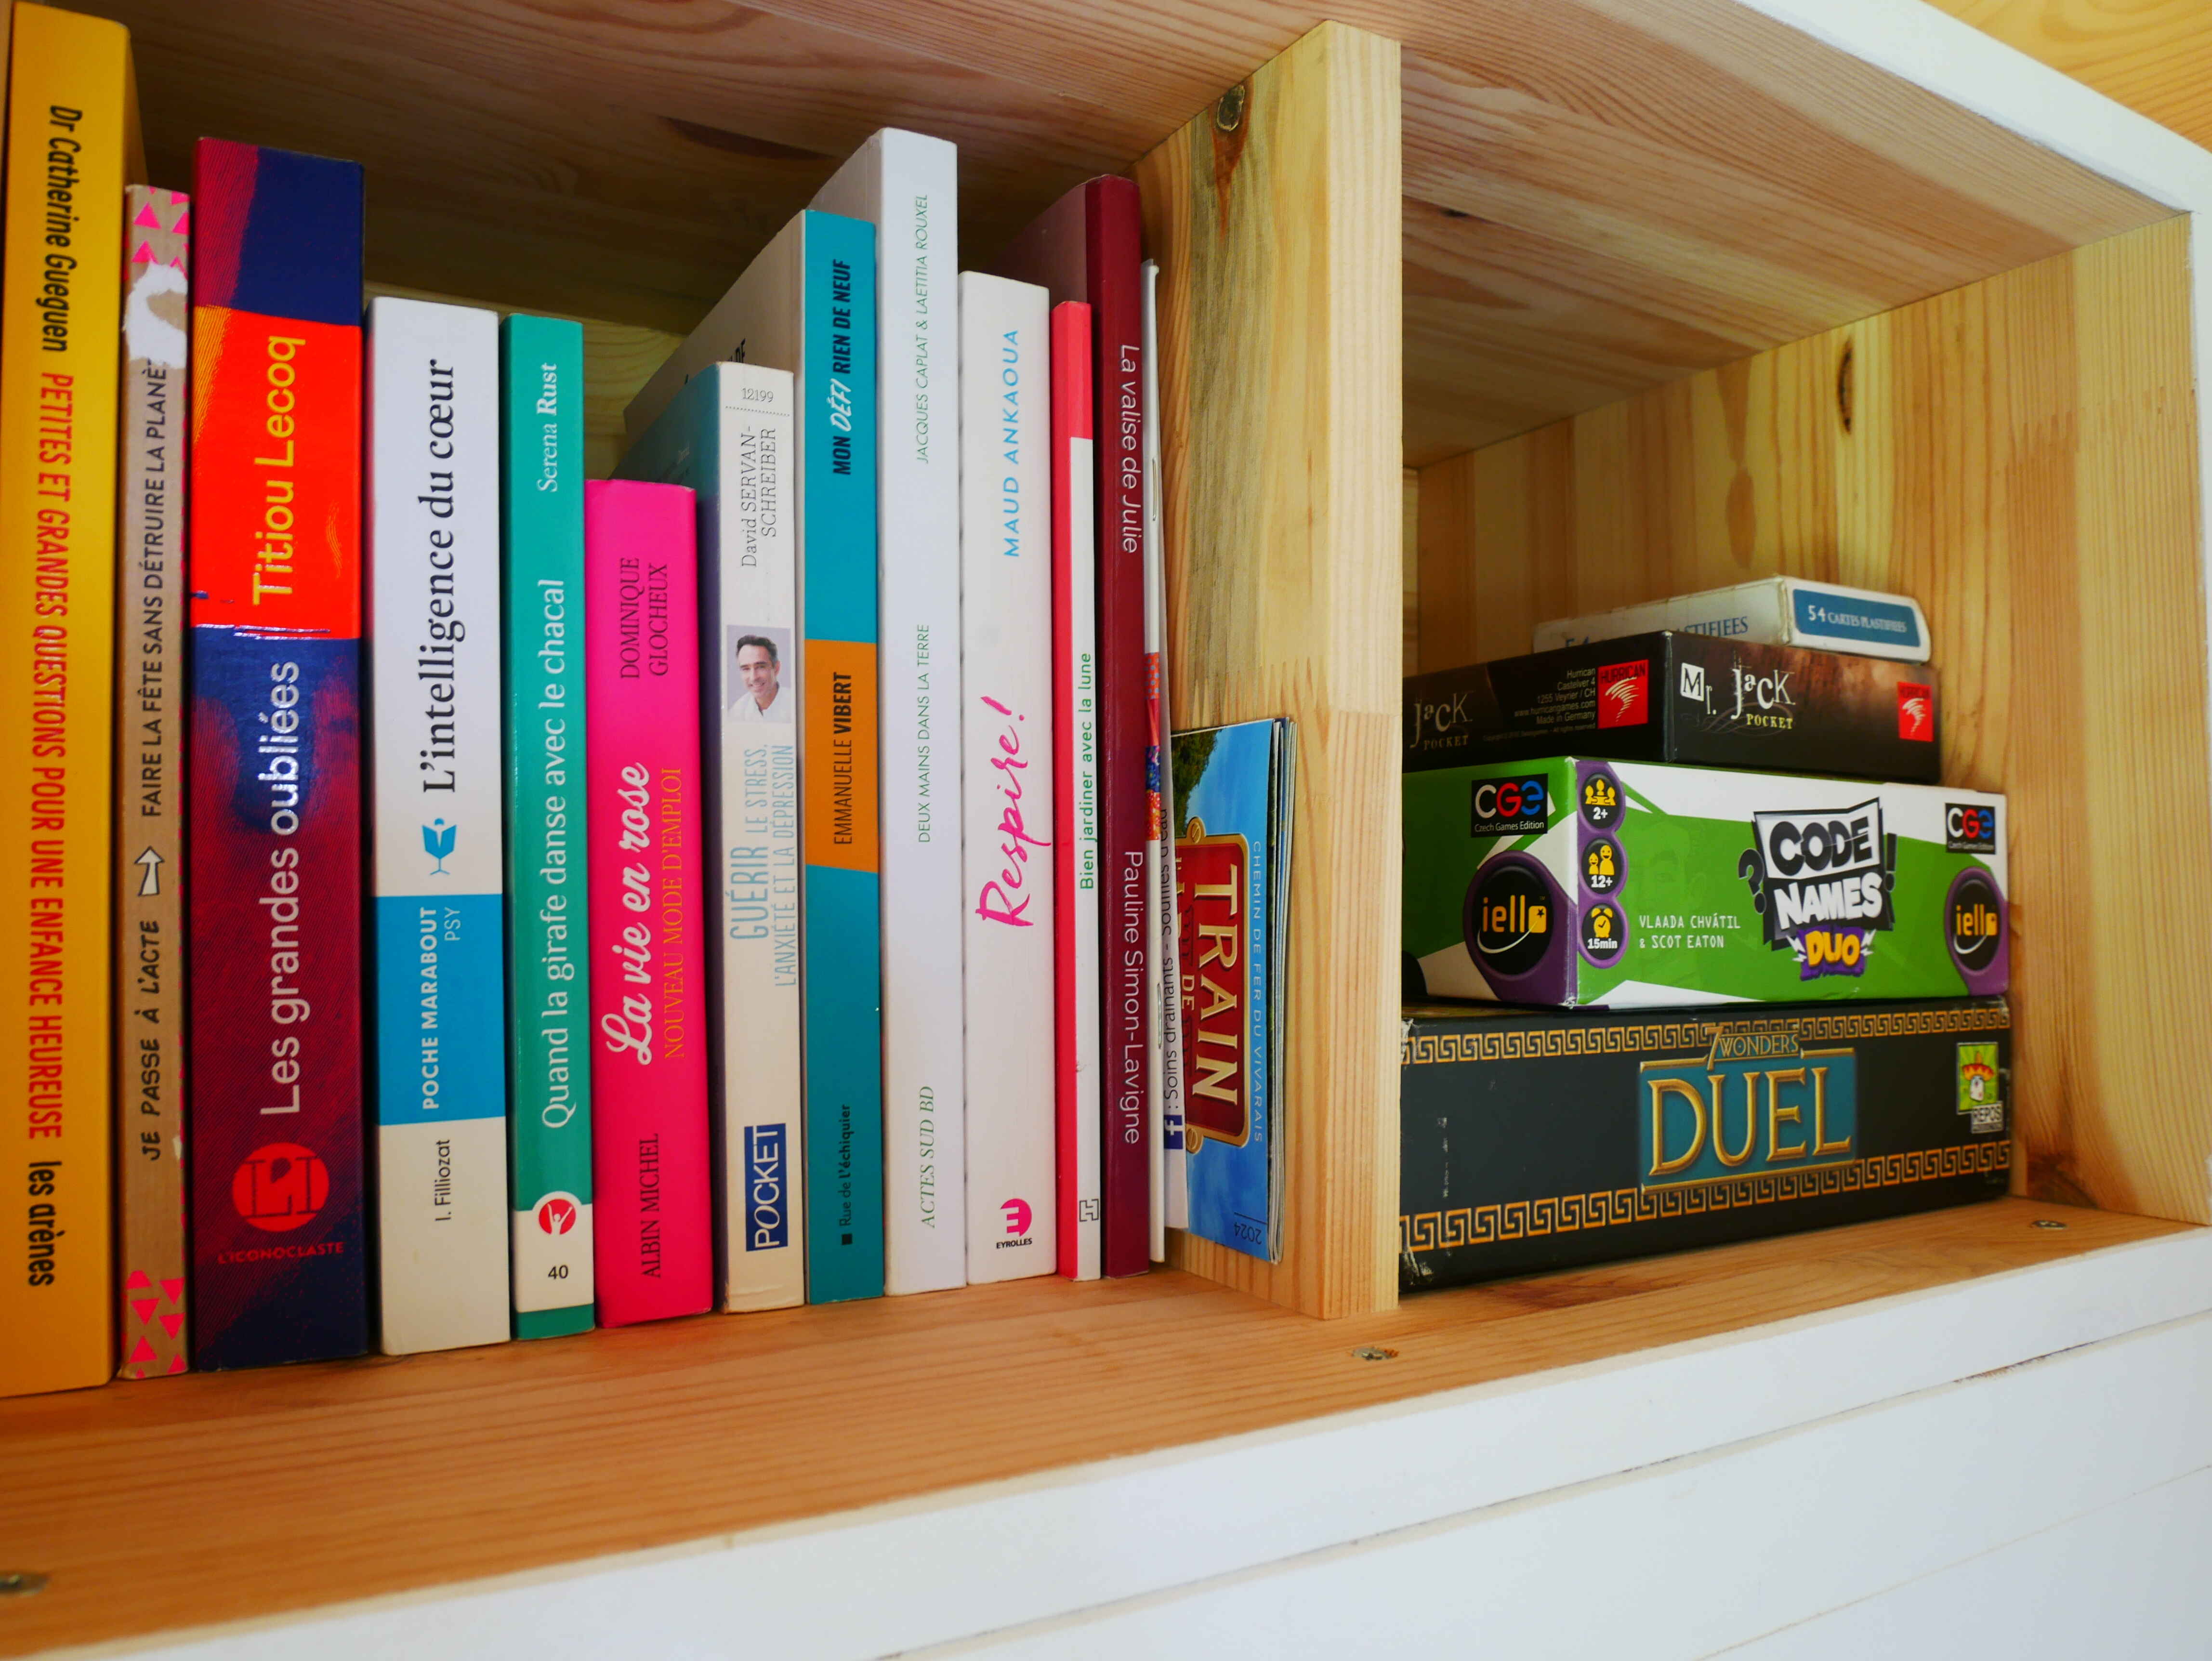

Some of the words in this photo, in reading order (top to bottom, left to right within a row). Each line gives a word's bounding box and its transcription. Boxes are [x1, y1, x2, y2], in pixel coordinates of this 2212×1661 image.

[50, 105, 82, 132] Dr
[45, 137, 81, 247] Catherine
[916, 194, 928, 250] ROUXEL
[36, 255, 77, 352] Gueguen
[833, 259, 851, 303] NEUF
[916, 256, 928, 314] LAETITIA
[833, 307, 851, 329] DE
[916, 319, 928, 330] &
[833, 334, 851, 374] RIEN
[916, 335, 928, 389] CAPLAT
[1120, 344, 1140, 373] La
[254, 335, 306, 467] Lecoq
[429, 358, 454, 459] cœur
[537, 362, 557, 416] Rust
[742, 388, 774, 403] 12199
[827, 378, 852, 432] DÉFI
[1002, 330, 1019, 464] ANKAOUA
[1121, 381, 1141, 451] valise
[39, 373, 73, 464] PETITES
[917, 394, 929, 464] JACQUES
[146, 446, 165, 472] LA
[537, 422, 557, 493] Serena
[741, 426, 757, 513] SERVAN-
[761, 428, 777, 537] SCHREIBER
[833, 436, 851, 475] MON
[1121, 456, 1142, 490] de
[38, 473, 71, 501] ET
[418, 471, 454, 519] du
[138, 479, 164, 590] DÉTRUIRE
[253, 480, 294, 605] Titiou
[741, 518, 757, 568] David
[1003, 476, 1019, 557] MAUD
[1122, 494, 1143, 554] Julie
[35, 509, 70, 617] GRANDES
[144, 592, 163, 654] SANS
[538, 579, 565, 674] chacal
[619, 557, 645, 679] DOMINIQUE
[649, 563, 669, 676] GLOCHEUX
[917, 624, 930, 666] TERRE
[137, 660, 162, 711] FÊTE
[418, 528, 465, 792] L'intelligence
[917, 673, 929, 690] LA
[1078, 653, 1092, 689] lune
[1567, 668, 1596, 679] Hurrican
[1600, 663, 1646, 683] HURRICAN
[32, 625, 67, 758] QUESTIONS
[539, 682, 565, 709] le
[833, 672, 852, 734] VIBERT
[917, 696, 929, 740] DANS
[1078, 698, 1093, 718] la
[1514, 699, 1596, 717] www.hurricangames.com
[1536, 715, 1554, 725] Made
[1564, 711, 1596, 722] Germany
[1584, 687, 1596, 698] CH
[143, 719, 161, 746] LA
[1081, 721, 1093, 762] avec
[1423, 735, 1469, 751] POCKET
[1746, 713, 1793, 729] POCKET
[257, 661, 299, 836] oubliées
[544, 718, 566, 786] avec
[918, 745, 930, 797] MAINS
[31, 767, 66, 830] POUR
[142, 753, 161, 817] FAIRE
[744, 744, 768, 808] STRESS,
[769, 744, 795, 839] DÉPRESSION
[833, 739, 853, 845] EMMANUELLE
[617, 761, 650, 853] rose
[661, 767, 682, 871] D'EMPLOI
[745, 815, 768, 833] LE
[918, 803, 930, 842] DEUX
[1079, 771, 1097, 842] jardiner
[1475, 823, 1494, 832] Czech
[1495, 822, 1518, 831] Games
[1520, 820, 1544, 830] Edition
[1593, 807, 1608, 819] 2+
[30, 840, 64, 888] UNE
[540, 795, 566, 885] danse
[773, 846, 795, 867] LA
[1769, 816, 1872, 876] CODE
[622, 863, 651, 913] en
[725, 846, 769, 939] GUÉRIR
[774, 875, 795, 893] ET
[1080, 849, 1093, 889] Bien
[1591, 875, 1613, 888] 12+
[444, 907, 461, 941] PSY
[662, 877, 683, 944] MODE
[1124, 851, 1144, 944] Pauline
[1482, 895, 1547, 934] iello
[1639, 915, 1684, 928] VLAADA
[1690, 913, 1741, 928] CHVÁTIL
[1774, 872, 1883, 930] NAMES
[1957, 904, 1997, 936] iello
[29, 898, 64, 1006] ENFANCE
[137, 921, 159, 994] L'ACTE
[259, 847, 311, 1024] grandes
[540, 894, 574, 981] girafe
[612, 922, 651, 984] vie
[774, 902, 796, 987] L'ANXIÉTÉ
[1253, 929, 1261, 954] DE
[1587, 938, 1618, 949] 15min
[1640, 938, 1646, 949] &
[1651, 935, 1681, 949] SCOT
[1687, 935, 1724, 949] EATON
[1805, 930, 1861, 967] DUO
[420, 907, 437, 1029] MARABOUT
[1182, 975, 1195, 1011] DE
[1193, 864, 1238, 1105] TRAIN
[134, 1008, 159, 1023] À
[542, 991, 568, 1018] la
[601, 993, 652, 1065] La
[664, 952, 685, 1059] NOUVEAU
[1254, 1010, 1261, 1037] DU
[422, 1038, 439, 1109] POCHE
[1119, 950, 1144, 1145] Simon-Lavigne
[1705, 1026, 1724, 1071] 7
[1719, 1033, 1799, 1058] WONDERS
[28, 1016, 63, 1139] HEUREUSE
[141, 1038, 160, 1116] PASSE
[260, 1038, 300, 1115] Les
[542, 1027, 577, 1129] Quand
[919, 1086, 934, 1112] BD
[1163, 1050, 1178, 1100] Soins
[1254, 1046, 1263, 1142] VIVARAIS
[142, 1131, 160, 1160] JE
[838, 1104, 855, 1179] l'échiquier
[920, 1119, 935, 1159] SUD
[1647, 1067, 1852, 1176] DUEL
[28, 1161, 62, 1196] les
[434, 1139, 451, 1206] Filliozat
[639, 1133, 659, 1213] MICHEL
[753, 1125, 780, 1248] POCKET
[838, 1181, 851, 1199] de
[920, 1163, 935, 1228] ACTES
[435, 1210, 451, 1221] I.
[839, 1201, 852, 1227] Rue
[28, 1203, 65, 1286] arènes
[217, 1241, 344, 1265] L'ICONOCLASTE
[640, 1220, 661, 1278] ALBIN
[996, 1238, 1032, 1249] EYROLLES
[548, 1265, 569, 1279] 40
